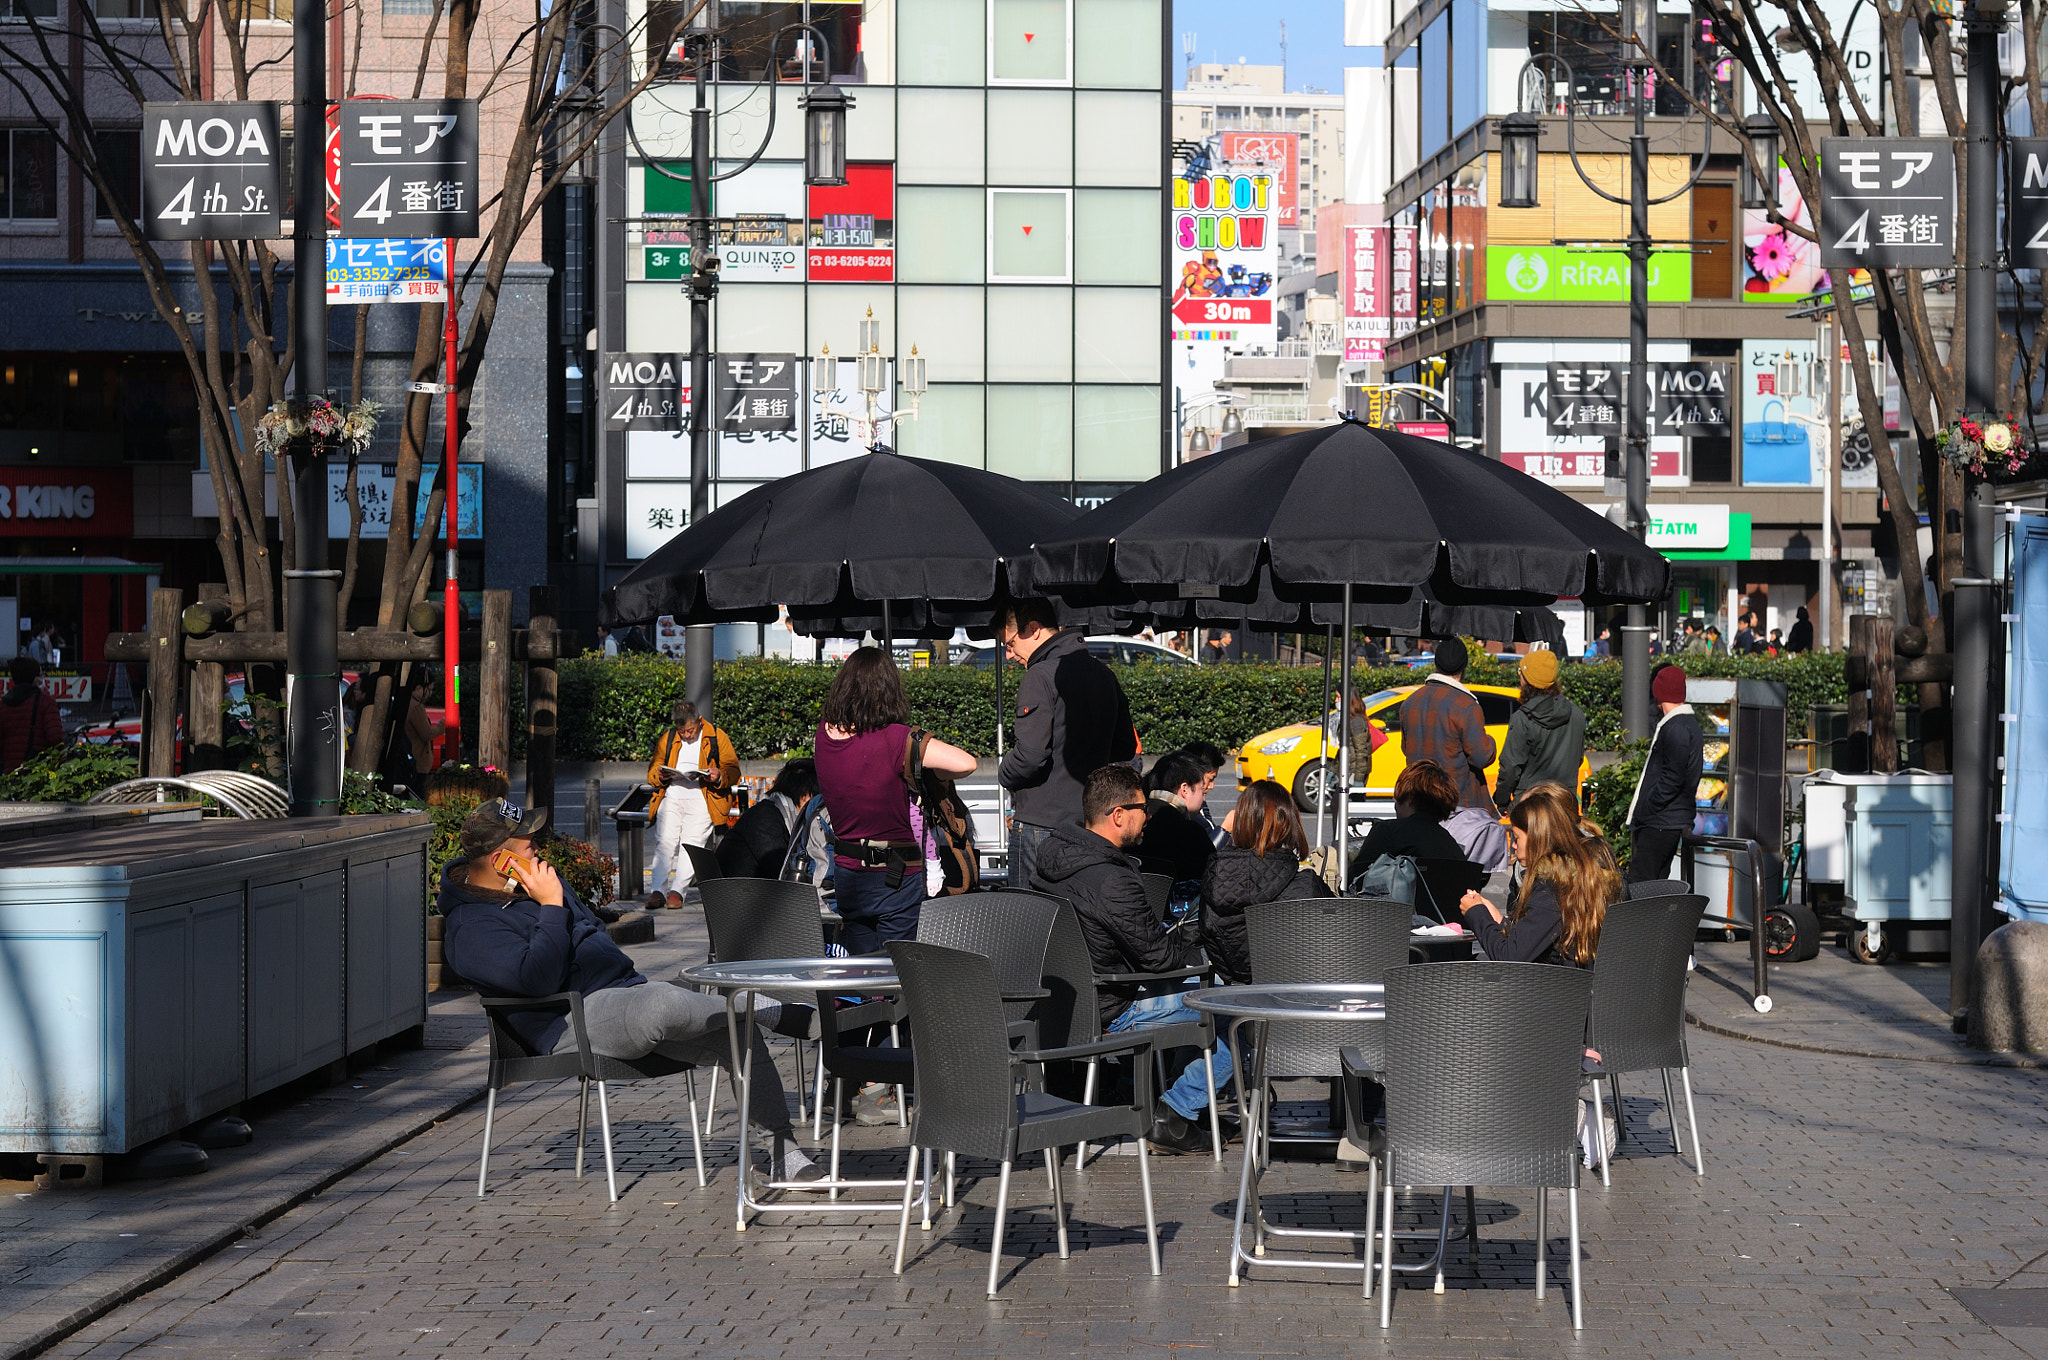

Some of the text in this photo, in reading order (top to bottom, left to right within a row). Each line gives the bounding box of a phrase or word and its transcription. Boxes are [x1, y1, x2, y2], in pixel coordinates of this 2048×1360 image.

[155, 118, 270, 157] MOA
[359, 115, 457, 155] モア
[1839, 152, 1933, 189] モア
[242, 185, 269, 212] St.
[353, 175, 464, 225] 4番街
[1173, 175, 1270, 210] ROBOT
[824, 215, 872, 229] LUNCH
[1178, 215, 1266, 249] SHOW
[1833, 208, 1939, 255] 4番街
[652, 252, 670, 267] 3F
[726, 251, 796, 264] QUINTO
[824, 256, 892, 267] 03-6205-6224
[330, 266, 430, 281] 03-3352-7325
[1353, 228, 1376, 314] 高価買取
[343, 282, 403, 297] 手前曲る
[78, 308, 205, 324] T-wig
[1204, 302, 1251, 320] 30m
[1172, 330, 1238, 340] RESTAURANT
[1348, 340, 1370, 350] 入口
[609, 362, 677, 384] MOA
[728, 361, 785, 384] モア
[1557, 370, 1611, 392] モア
[1661, 370, 1725, 392] MOA
[414, 383, 430, 391] 5m
[660, 400, 676, 415] St.
[724, 395, 788, 423] 4番街
[1553, 402, 1614, 429] 4番街
[1708, 407, 1724, 422] St.
[16, 485, 95, 518] KING
